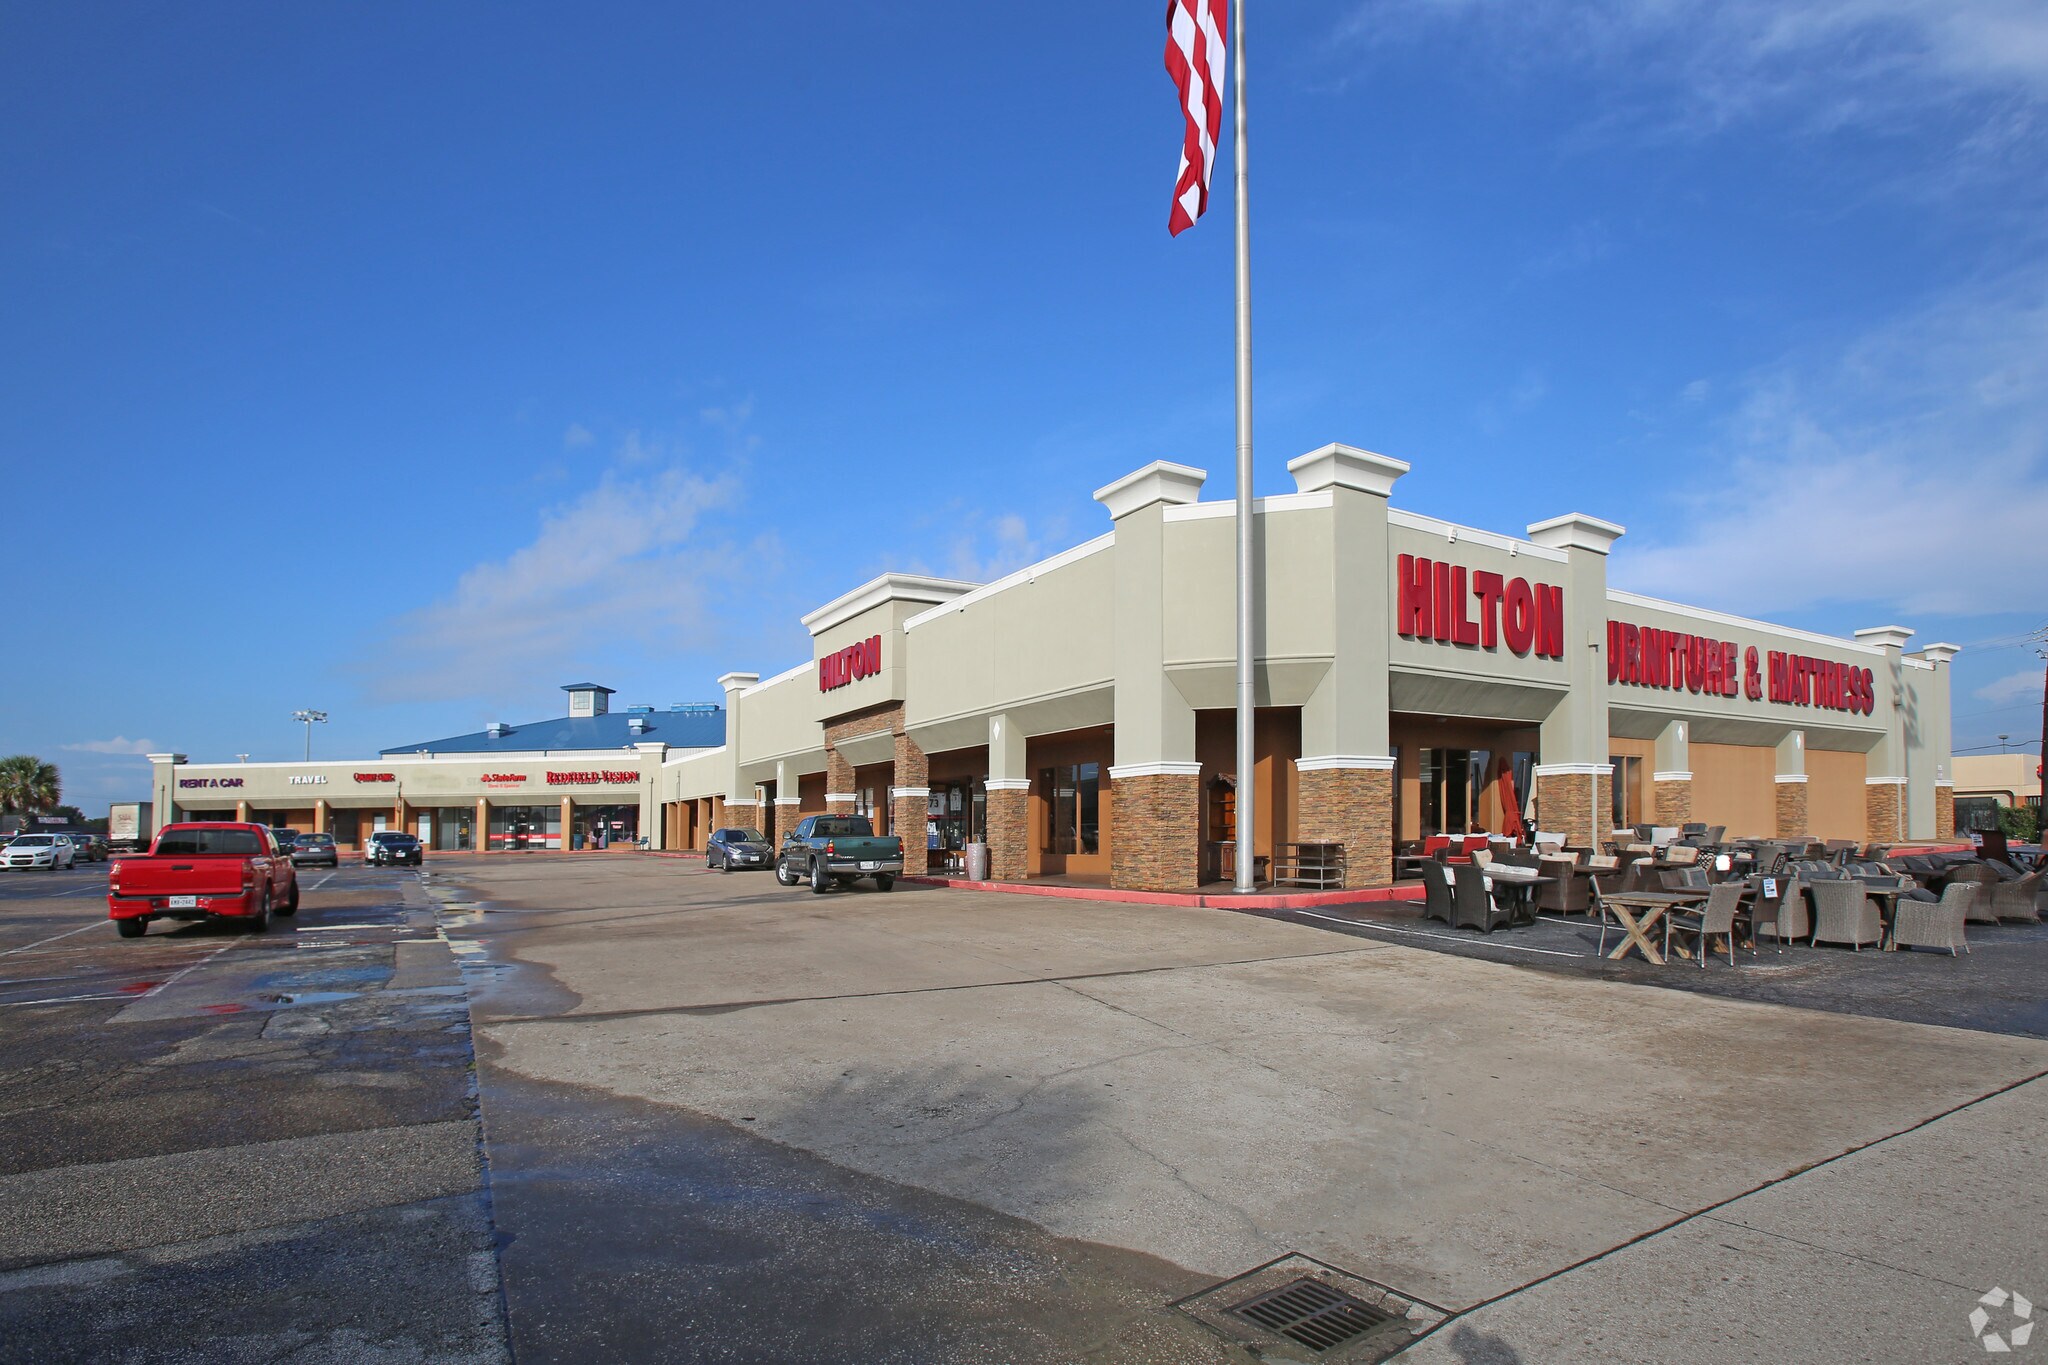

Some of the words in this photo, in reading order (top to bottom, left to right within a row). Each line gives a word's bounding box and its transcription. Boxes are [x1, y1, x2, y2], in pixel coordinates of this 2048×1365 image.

[1396, 553, 1564, 658] HILTON
[819, 634, 882, 693] HILTON
[1606, 619, 1739, 697] URNITURE
[1744, 645, 1763, 700] &
[1767, 649, 1875, 715] MATTRESS
[180, 778, 209, 788] RENT
[209, 778, 219, 788] A
[220, 778, 244, 788] CAR
[288, 774, 328, 785] TRAVEL
[546, 771, 600, 785] REDFIELD
[600, 770, 640, 784] VISION
